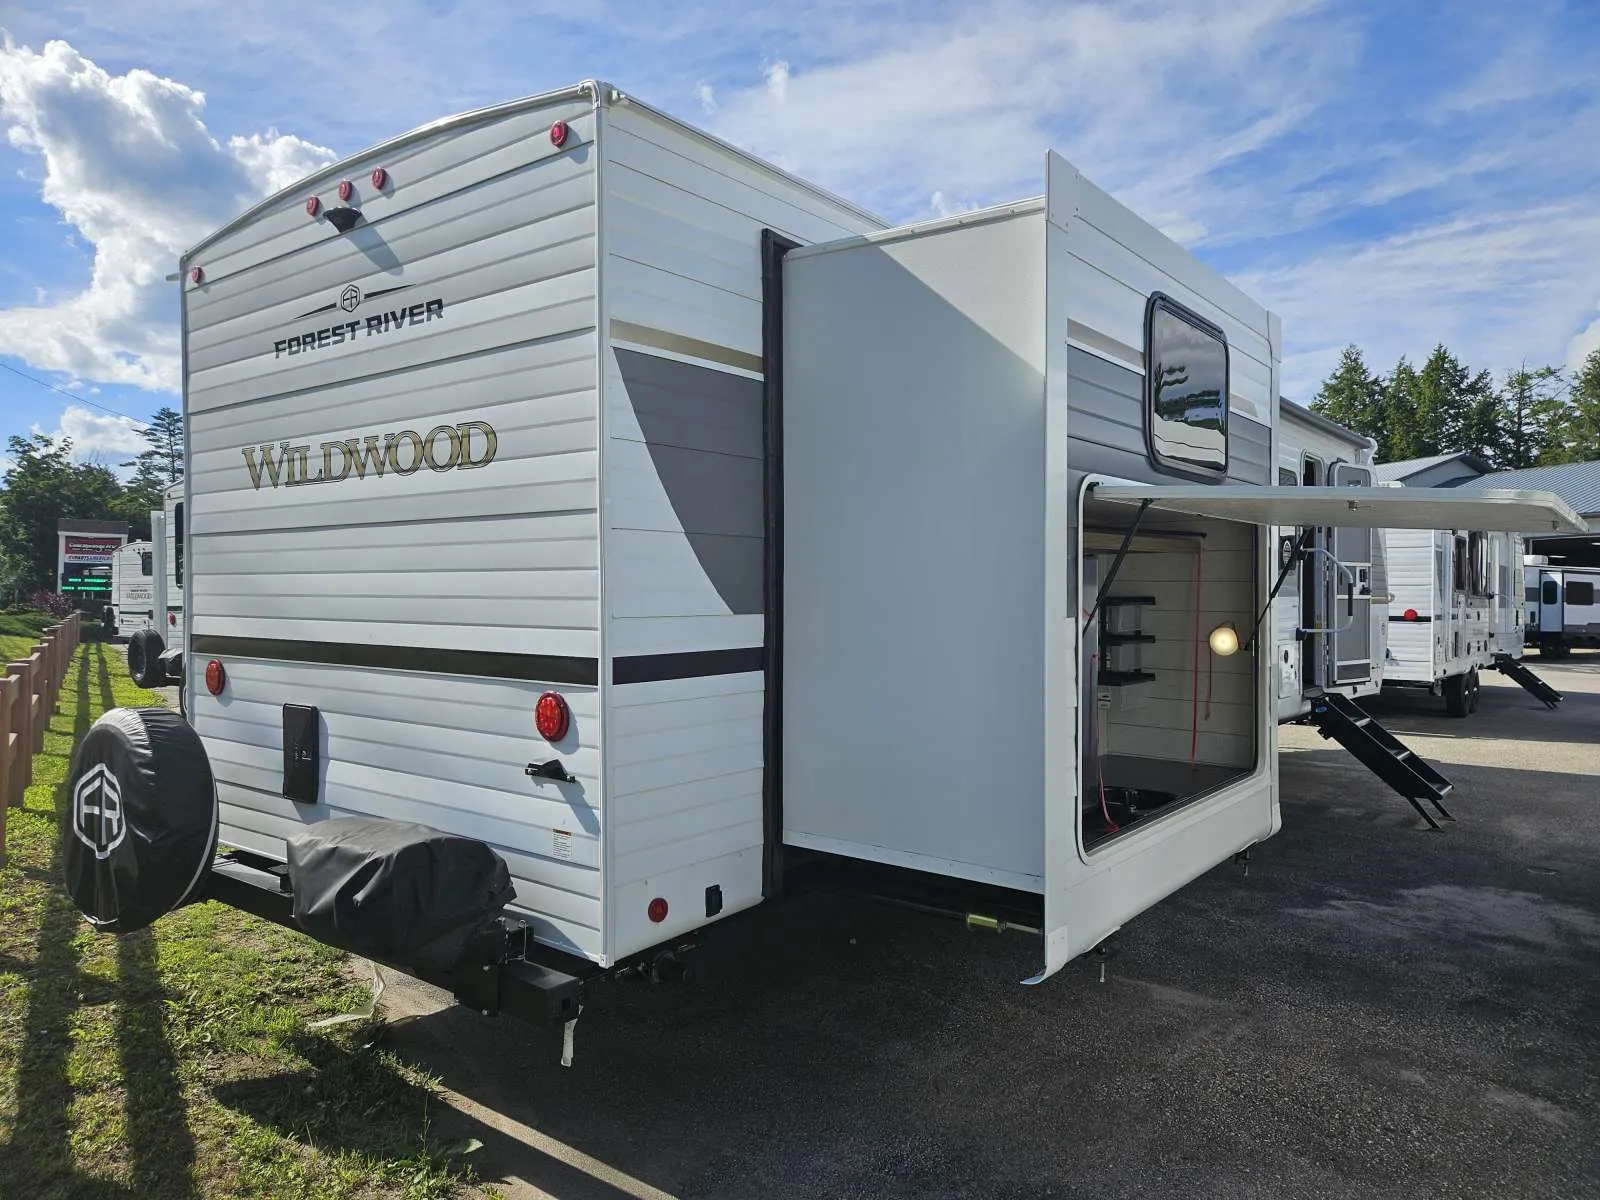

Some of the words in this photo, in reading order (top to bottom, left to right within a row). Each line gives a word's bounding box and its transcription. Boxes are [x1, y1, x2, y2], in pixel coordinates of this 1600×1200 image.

[273, 319, 361, 359] FOREST
[365, 298, 444, 337] RIVER
[241, 420, 498, 491] WILDWOOD
